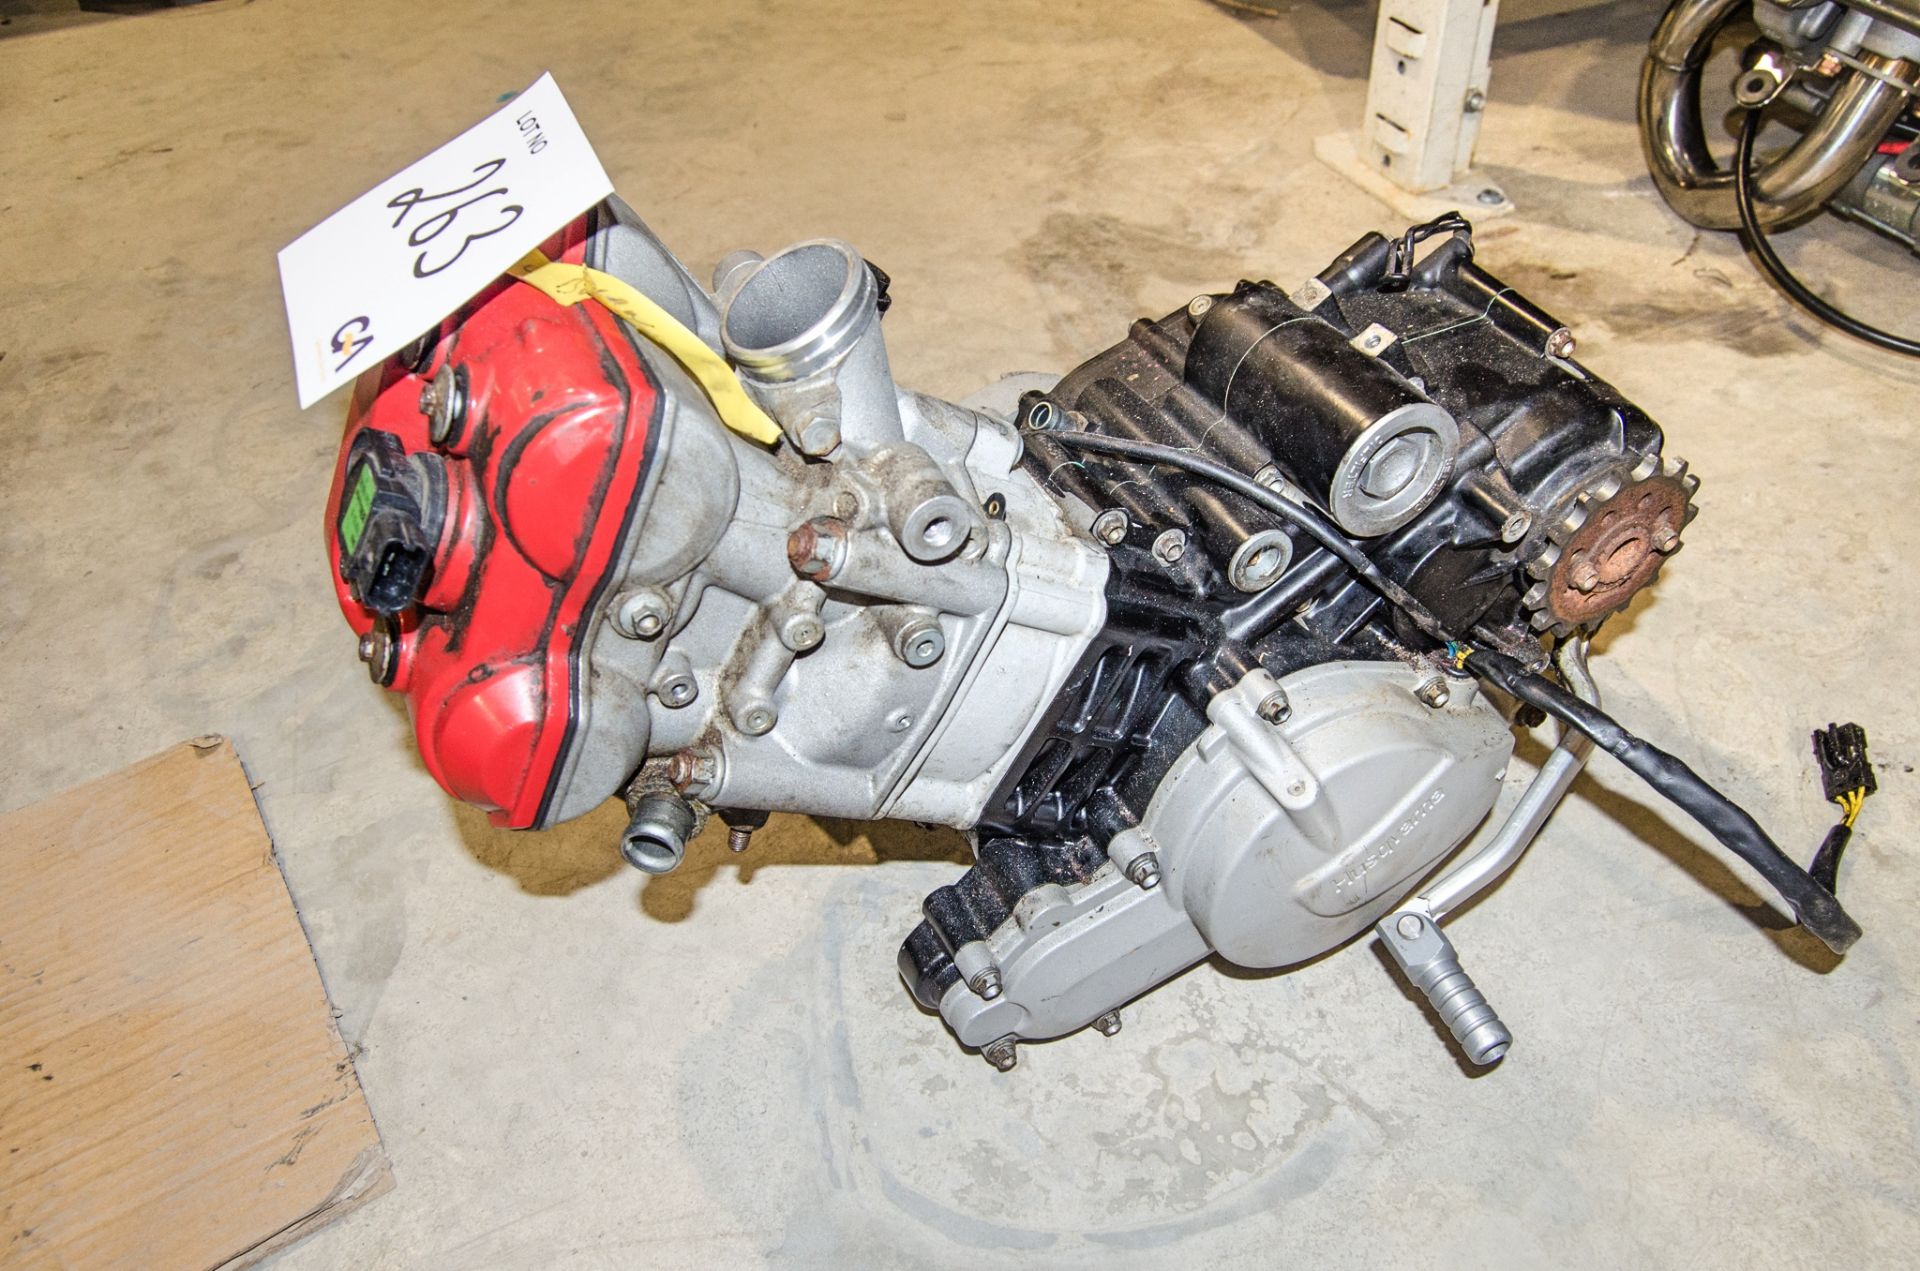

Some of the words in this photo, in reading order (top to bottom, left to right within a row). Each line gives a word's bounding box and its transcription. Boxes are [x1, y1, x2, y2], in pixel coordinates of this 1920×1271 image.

[516, 109, 541, 138] LOT
[526, 132, 549, 155] NO
[386, 158, 524, 279] 263
[1342, 452, 1367, 499] FILTER
